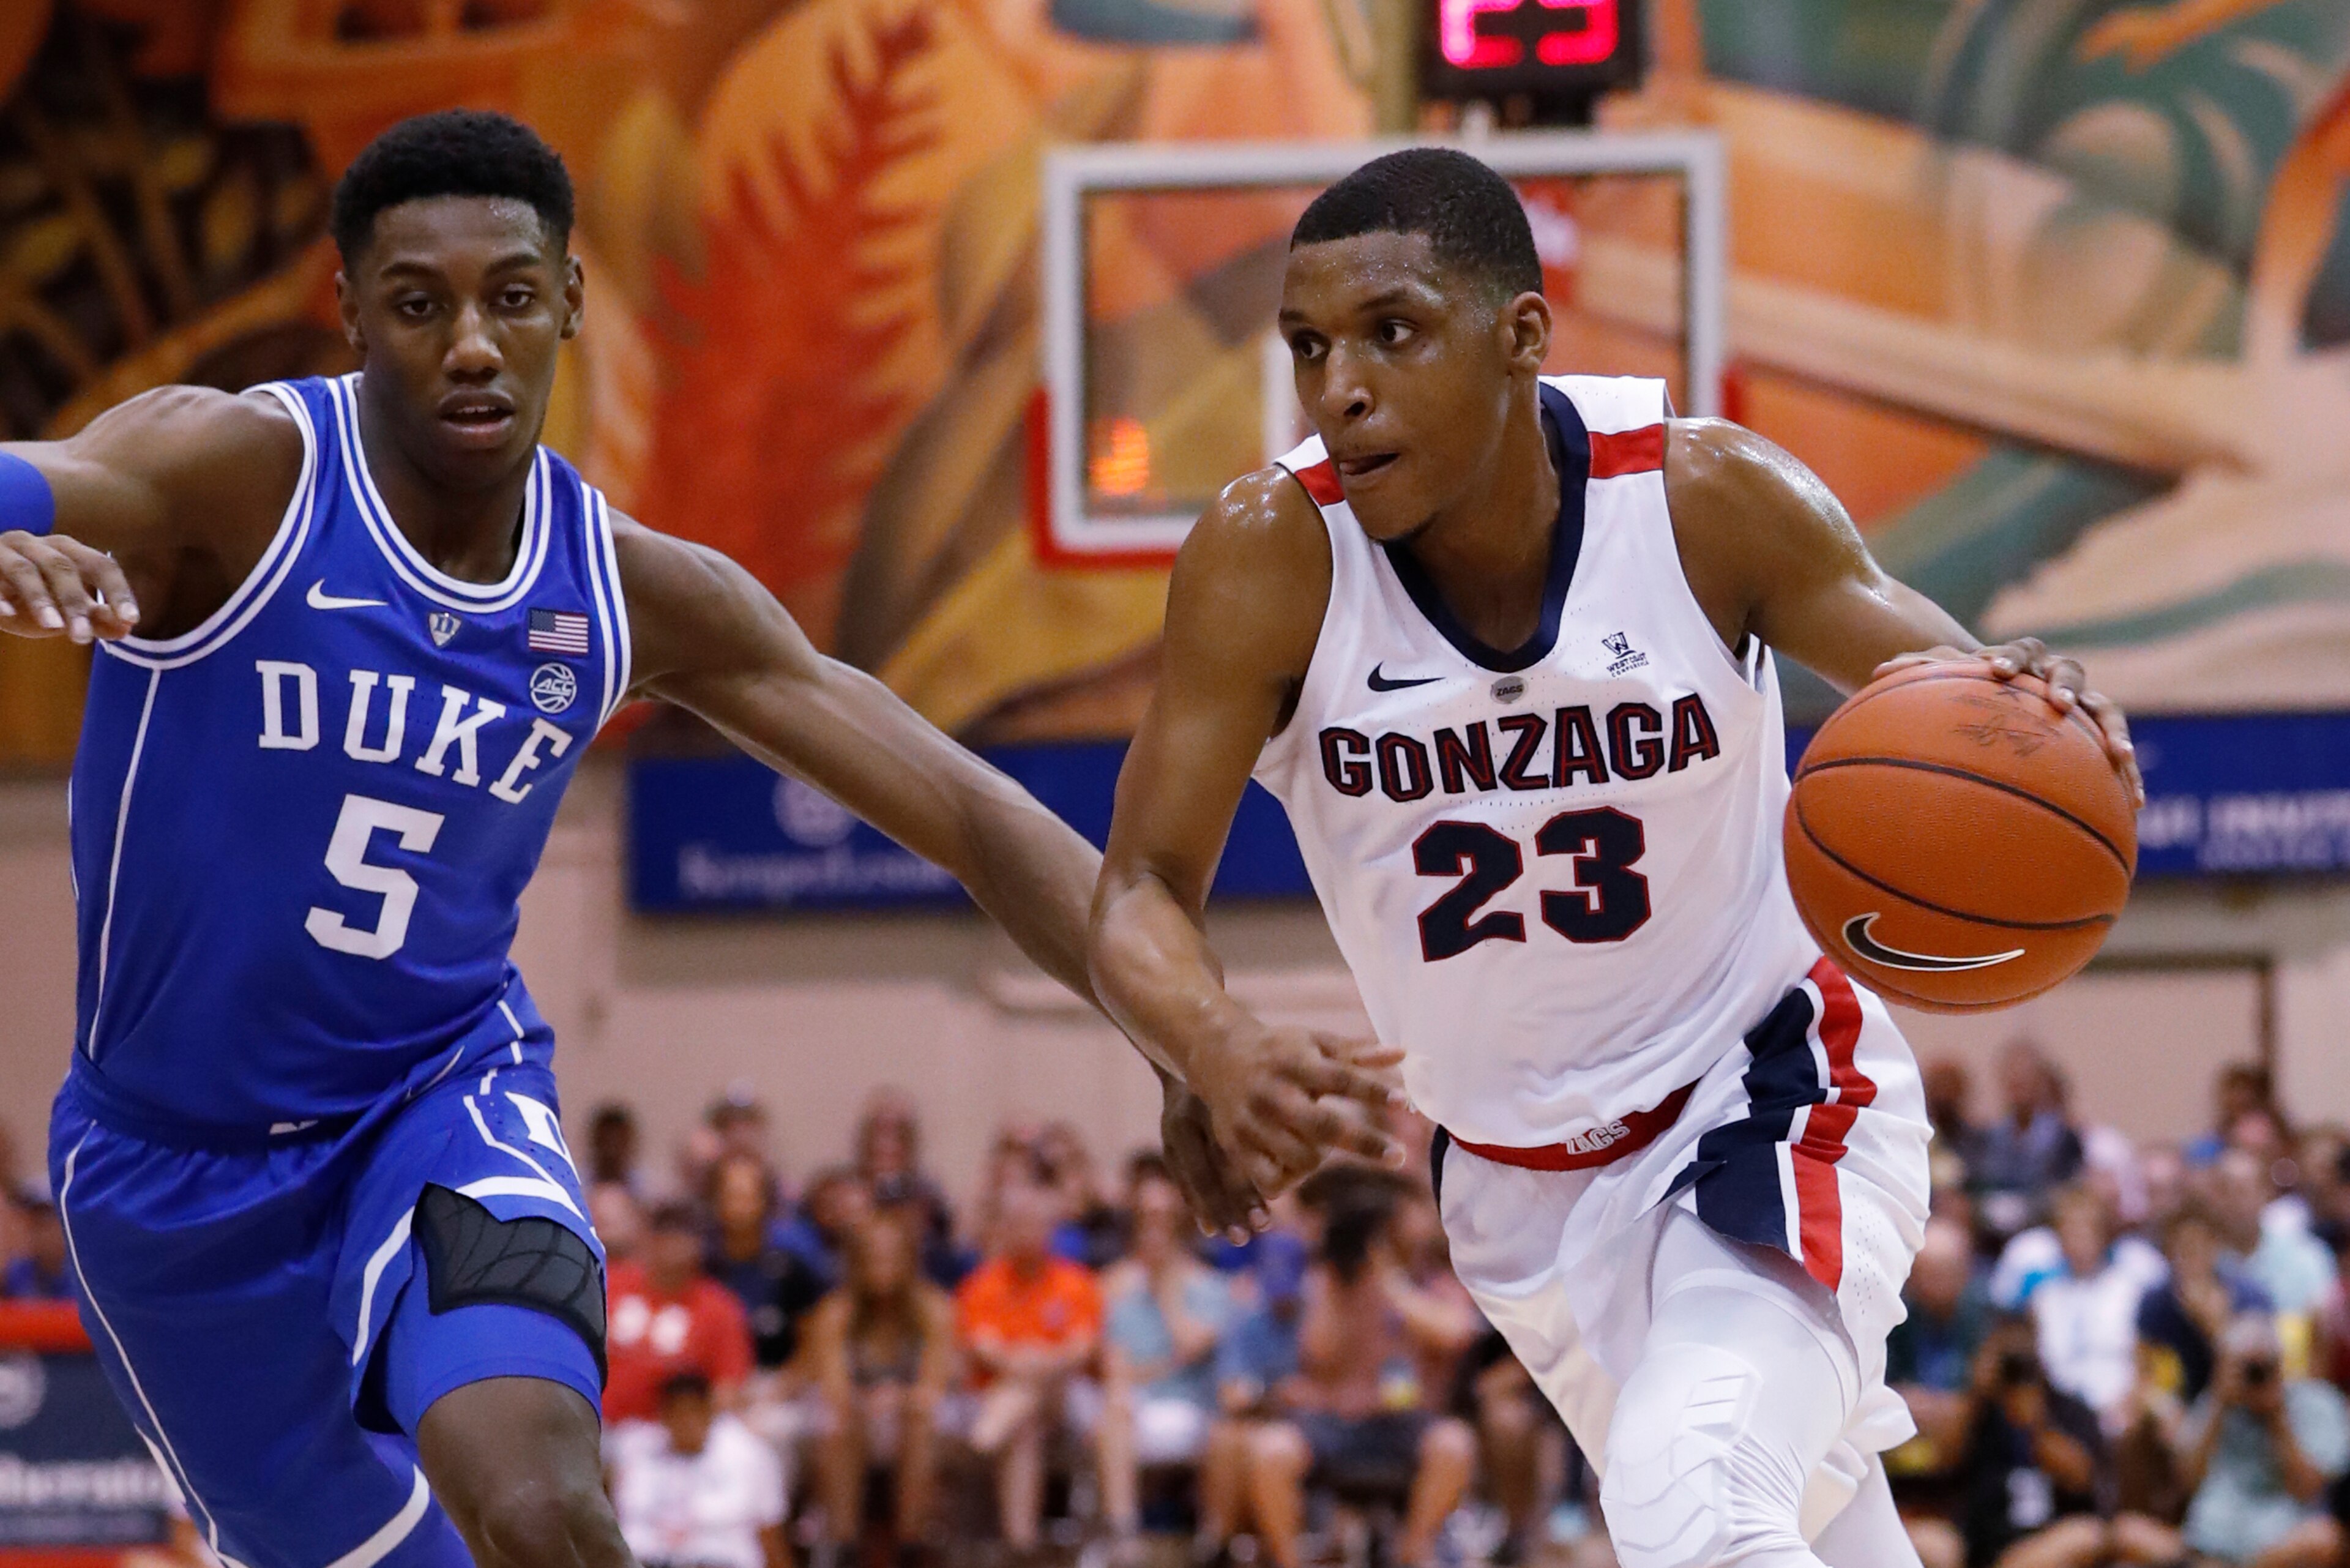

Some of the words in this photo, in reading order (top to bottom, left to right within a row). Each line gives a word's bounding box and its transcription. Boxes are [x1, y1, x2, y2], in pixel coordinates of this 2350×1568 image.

[534, 678, 574, 696] ACC
[1496, 684, 1523, 696] ZAGS
[1606, 659, 1628, 672] WEST
[255, 660, 573, 804] DUKE
[1319, 693, 1720, 803] GONZAGA
[305, 794, 445, 960] 5
[1412, 805, 1651, 962] 23
[1566, 1120, 1630, 1155] ZAGS
